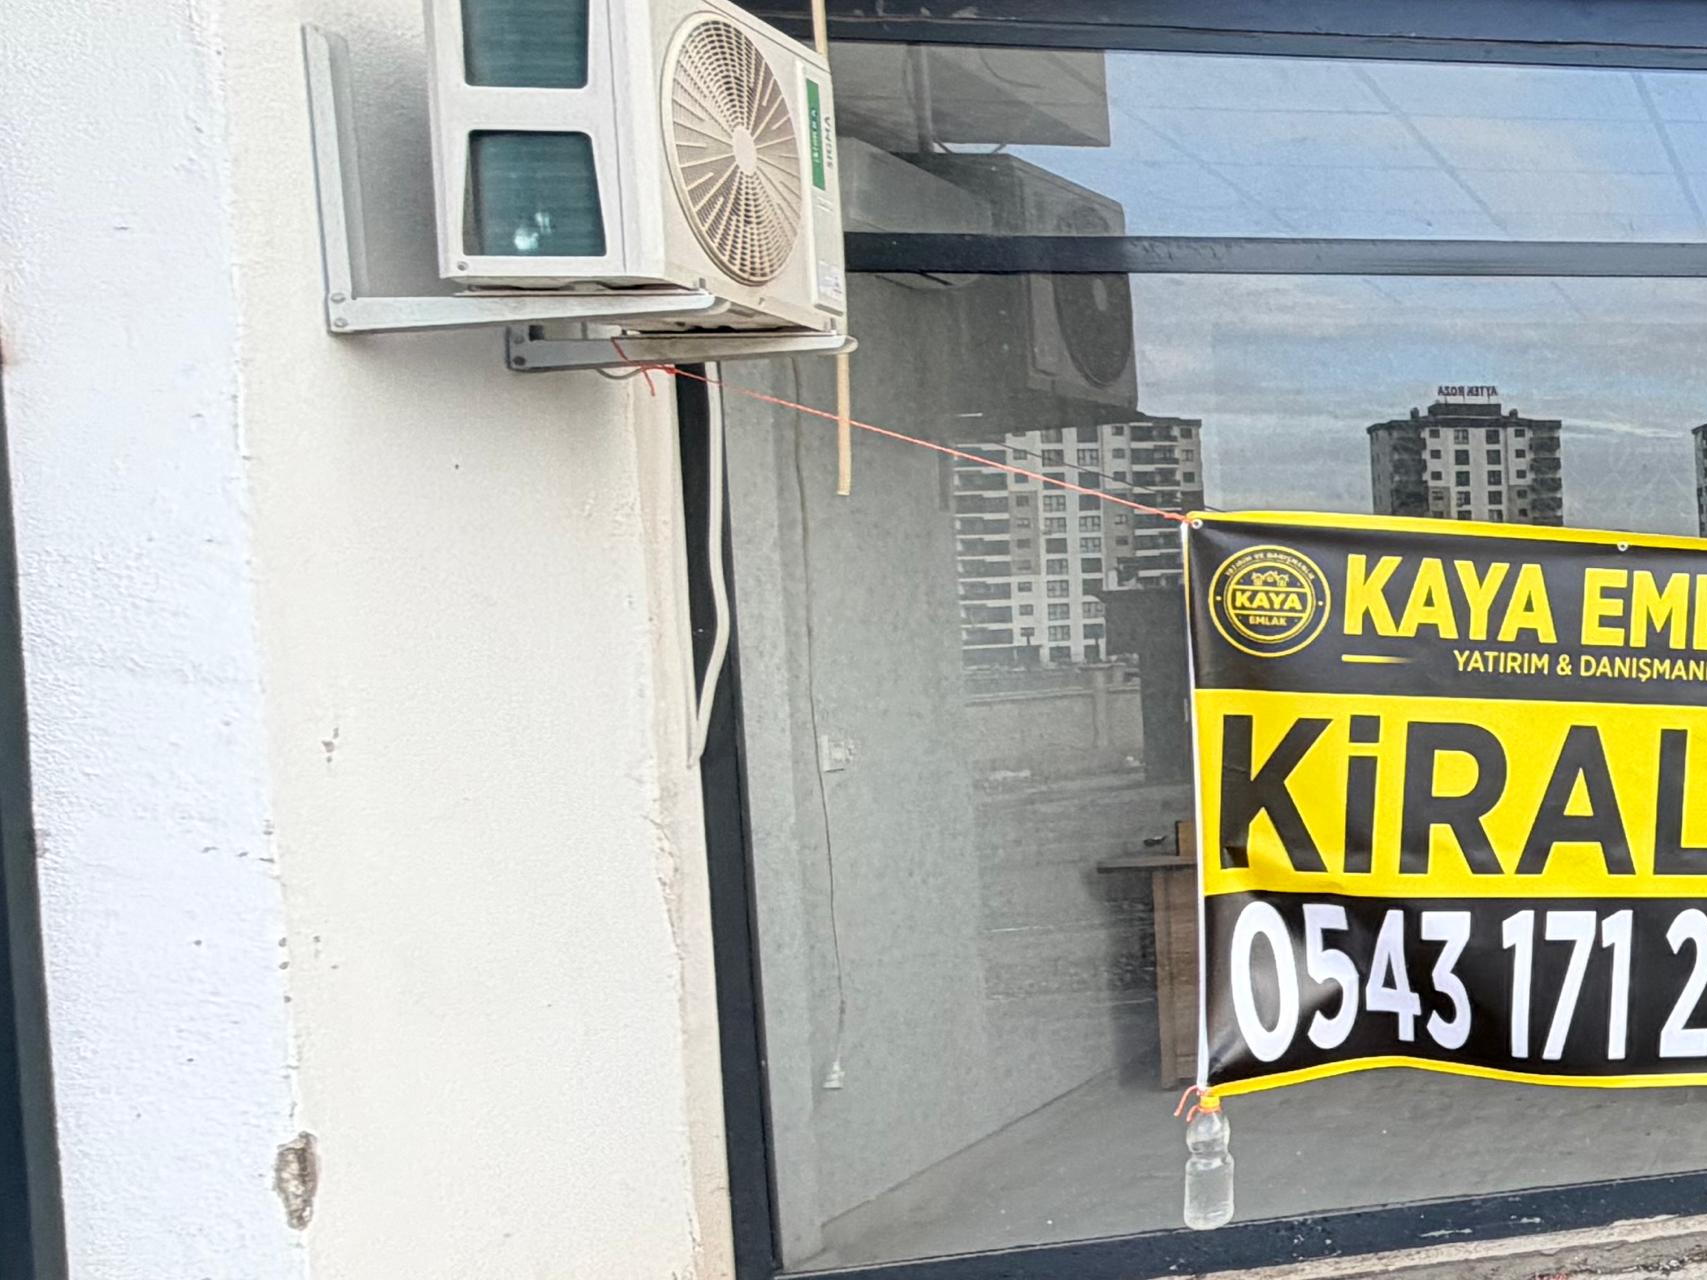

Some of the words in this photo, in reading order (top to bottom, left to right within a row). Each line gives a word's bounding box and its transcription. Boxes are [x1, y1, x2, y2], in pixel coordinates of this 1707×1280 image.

[1235, 591, 1302, 610] KAYA
[1344, 554, 1557, 644] KAYA
[1249, 616, 1287, 626] EMLAK
[1454, 650, 1549, 675] YATIRIM
[1556, 654, 1572, 676] &
[1230, 900, 1472, 1063] 0543
[1502, 909, 1633, 1060] 171
